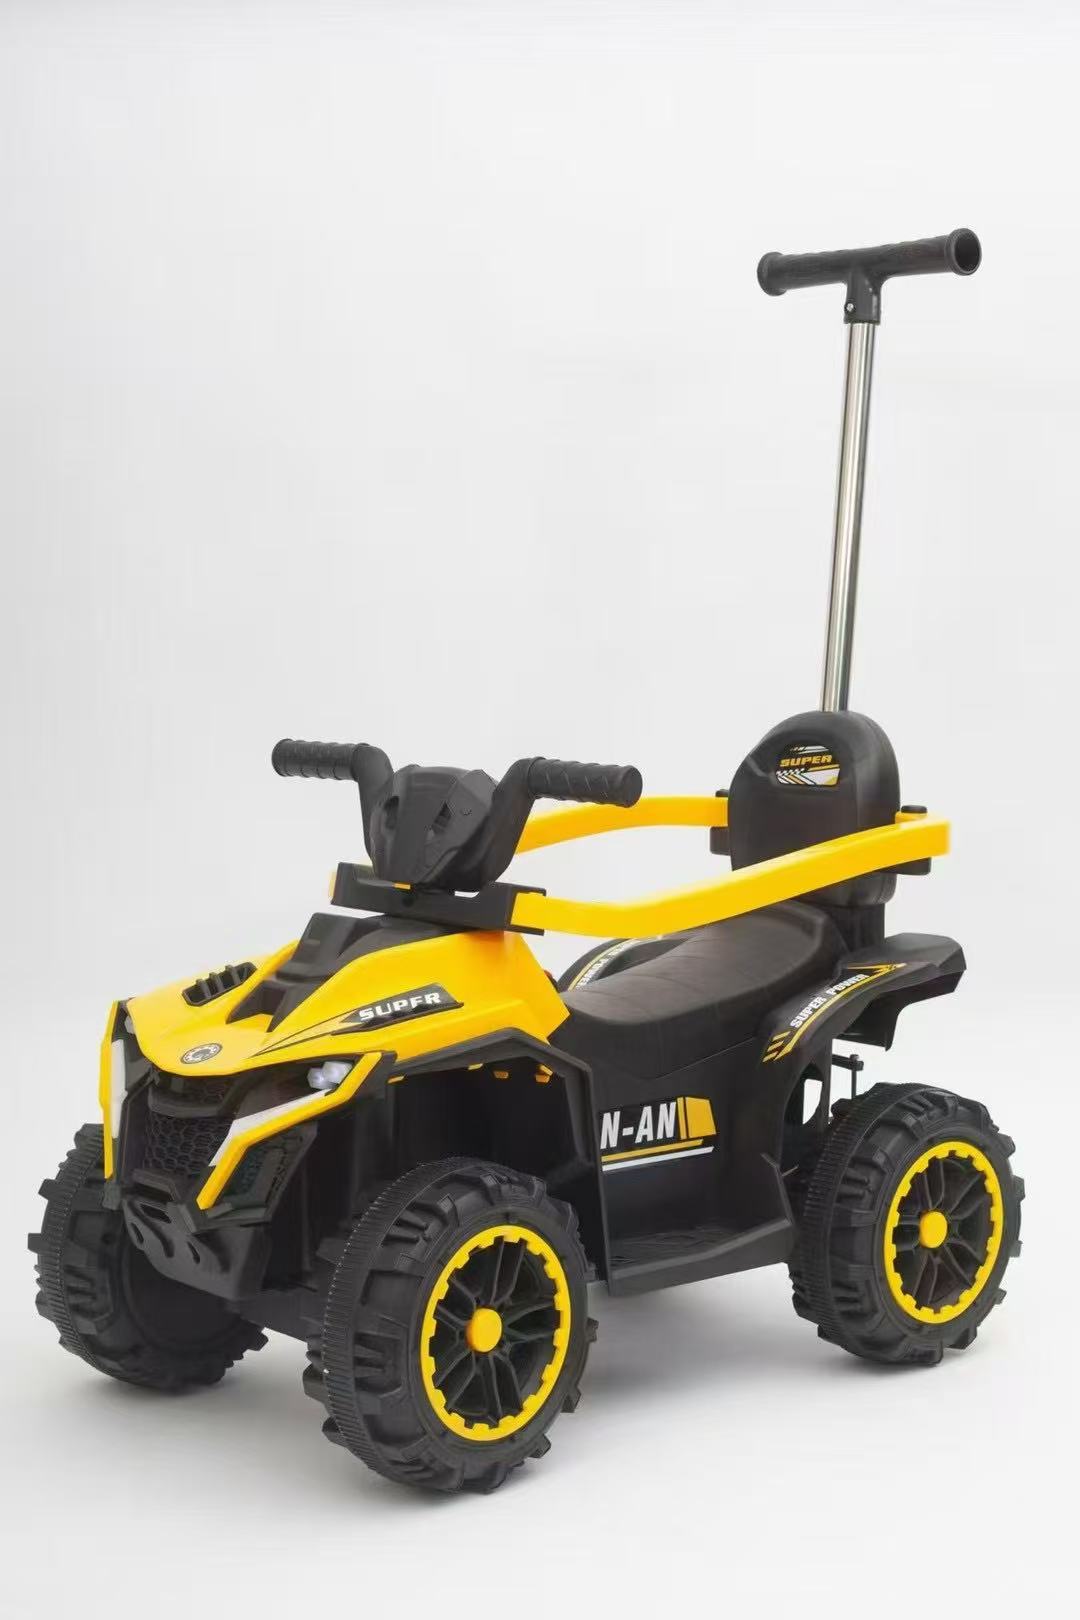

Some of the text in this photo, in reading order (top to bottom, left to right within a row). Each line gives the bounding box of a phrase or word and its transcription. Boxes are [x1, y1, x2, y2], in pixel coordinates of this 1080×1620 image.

[779, 754, 833, 767] SUPER
[789, 973, 871, 1028] SUPER POWER
